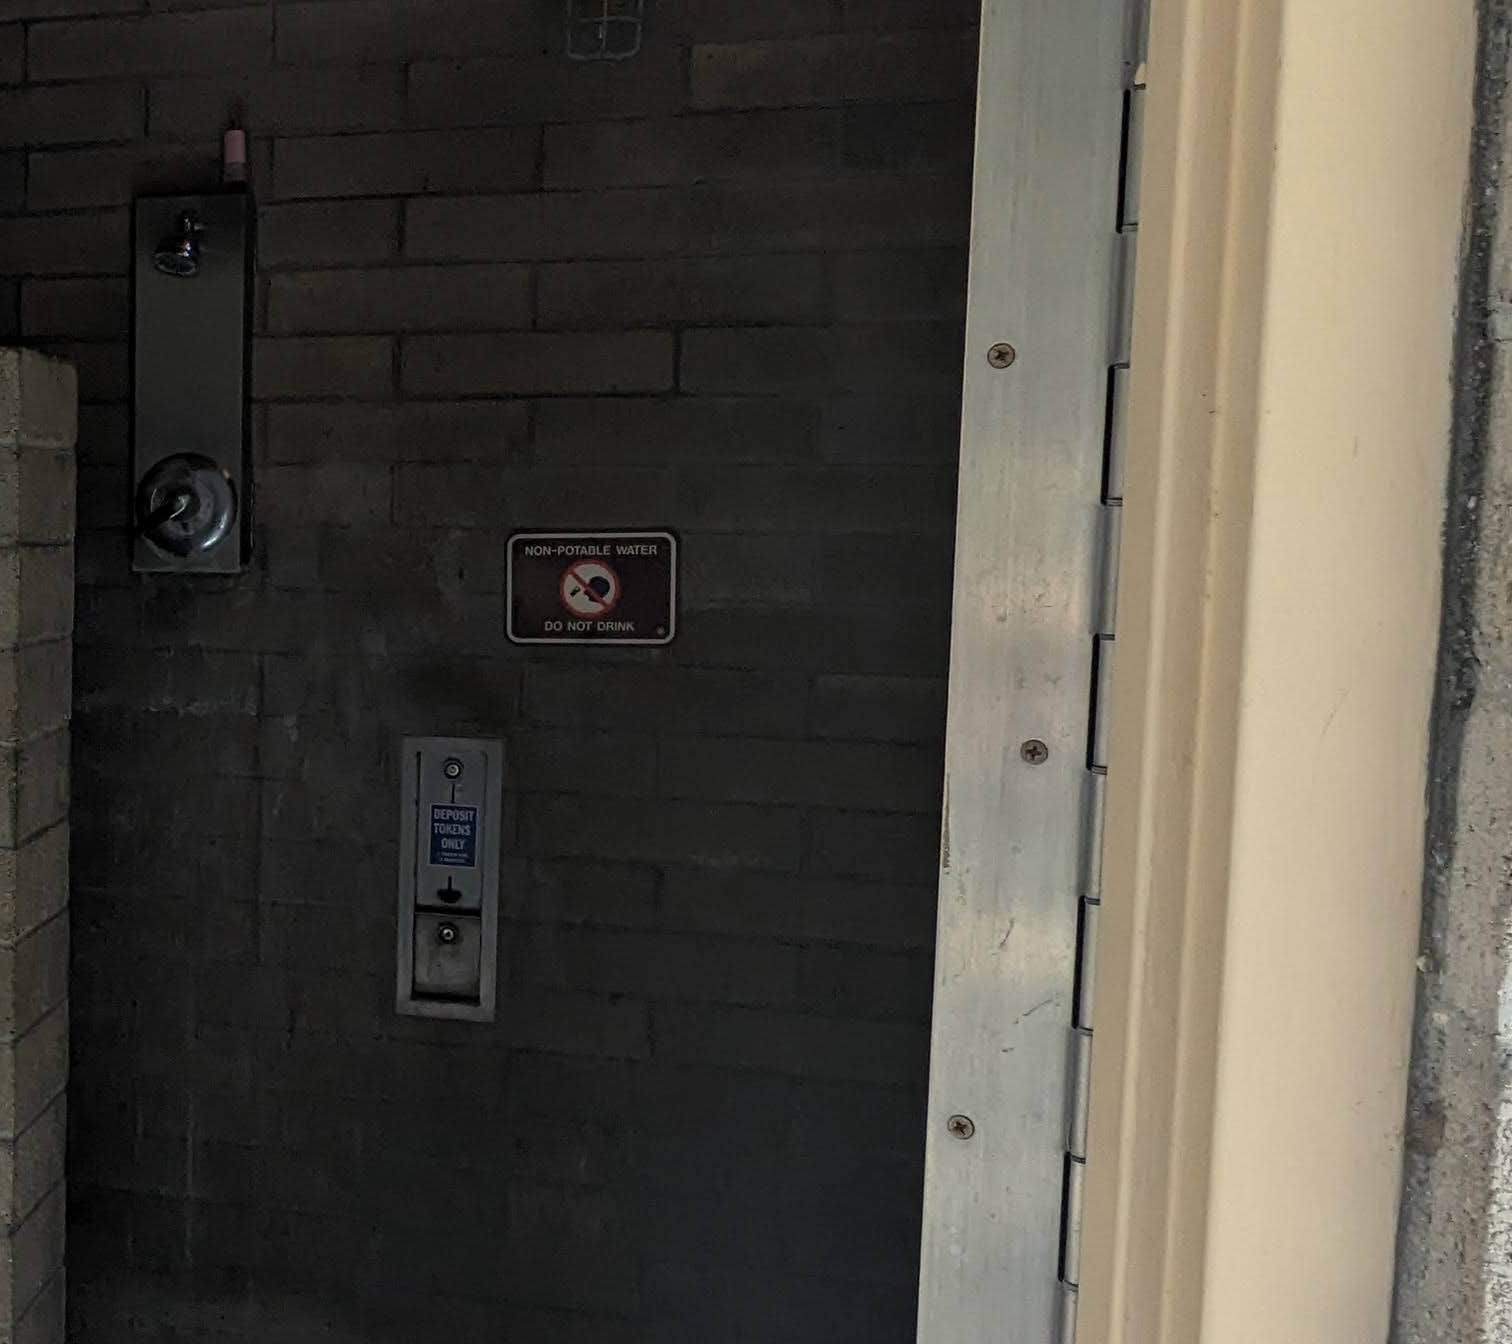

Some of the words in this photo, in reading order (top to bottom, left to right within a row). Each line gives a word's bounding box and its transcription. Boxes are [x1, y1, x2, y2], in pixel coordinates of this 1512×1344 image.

[524, 544, 611, 556] NON-POTABLE
[615, 544, 657, 556] WATER
[544, 620, 561, 632] DO
[567, 620, 593, 632] NOT
[597, 620, 634, 632] DRINK
[434, 808, 474, 821] DEPOSIT
[433, 822, 471, 835] TOKENS
[440, 838, 465, 850] ONLY
